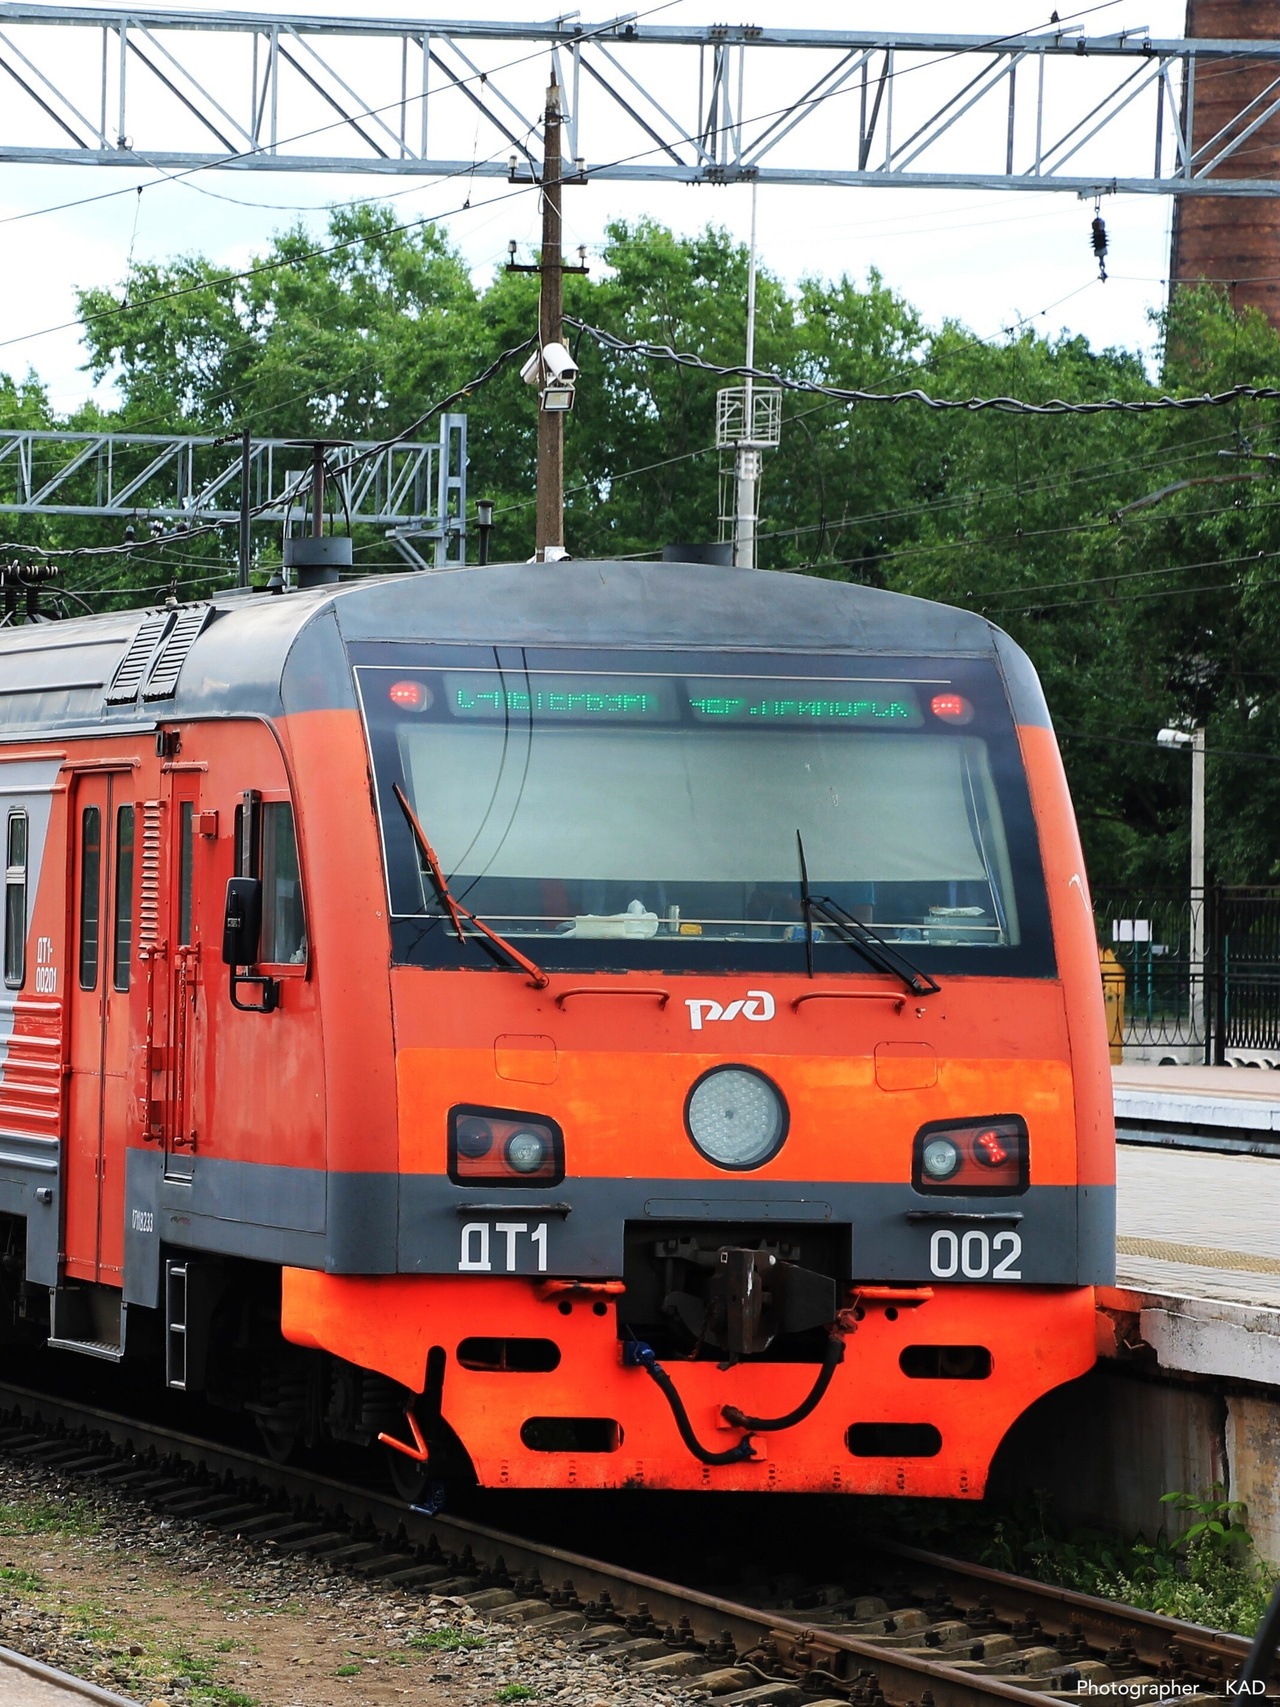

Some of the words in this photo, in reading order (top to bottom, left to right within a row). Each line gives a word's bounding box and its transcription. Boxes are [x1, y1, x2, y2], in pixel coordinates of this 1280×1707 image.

[35, 967, 57, 993] 00201
[458, 1222, 547, 1272] ДТ1
[930, 1229, 1022, 1280] 002
